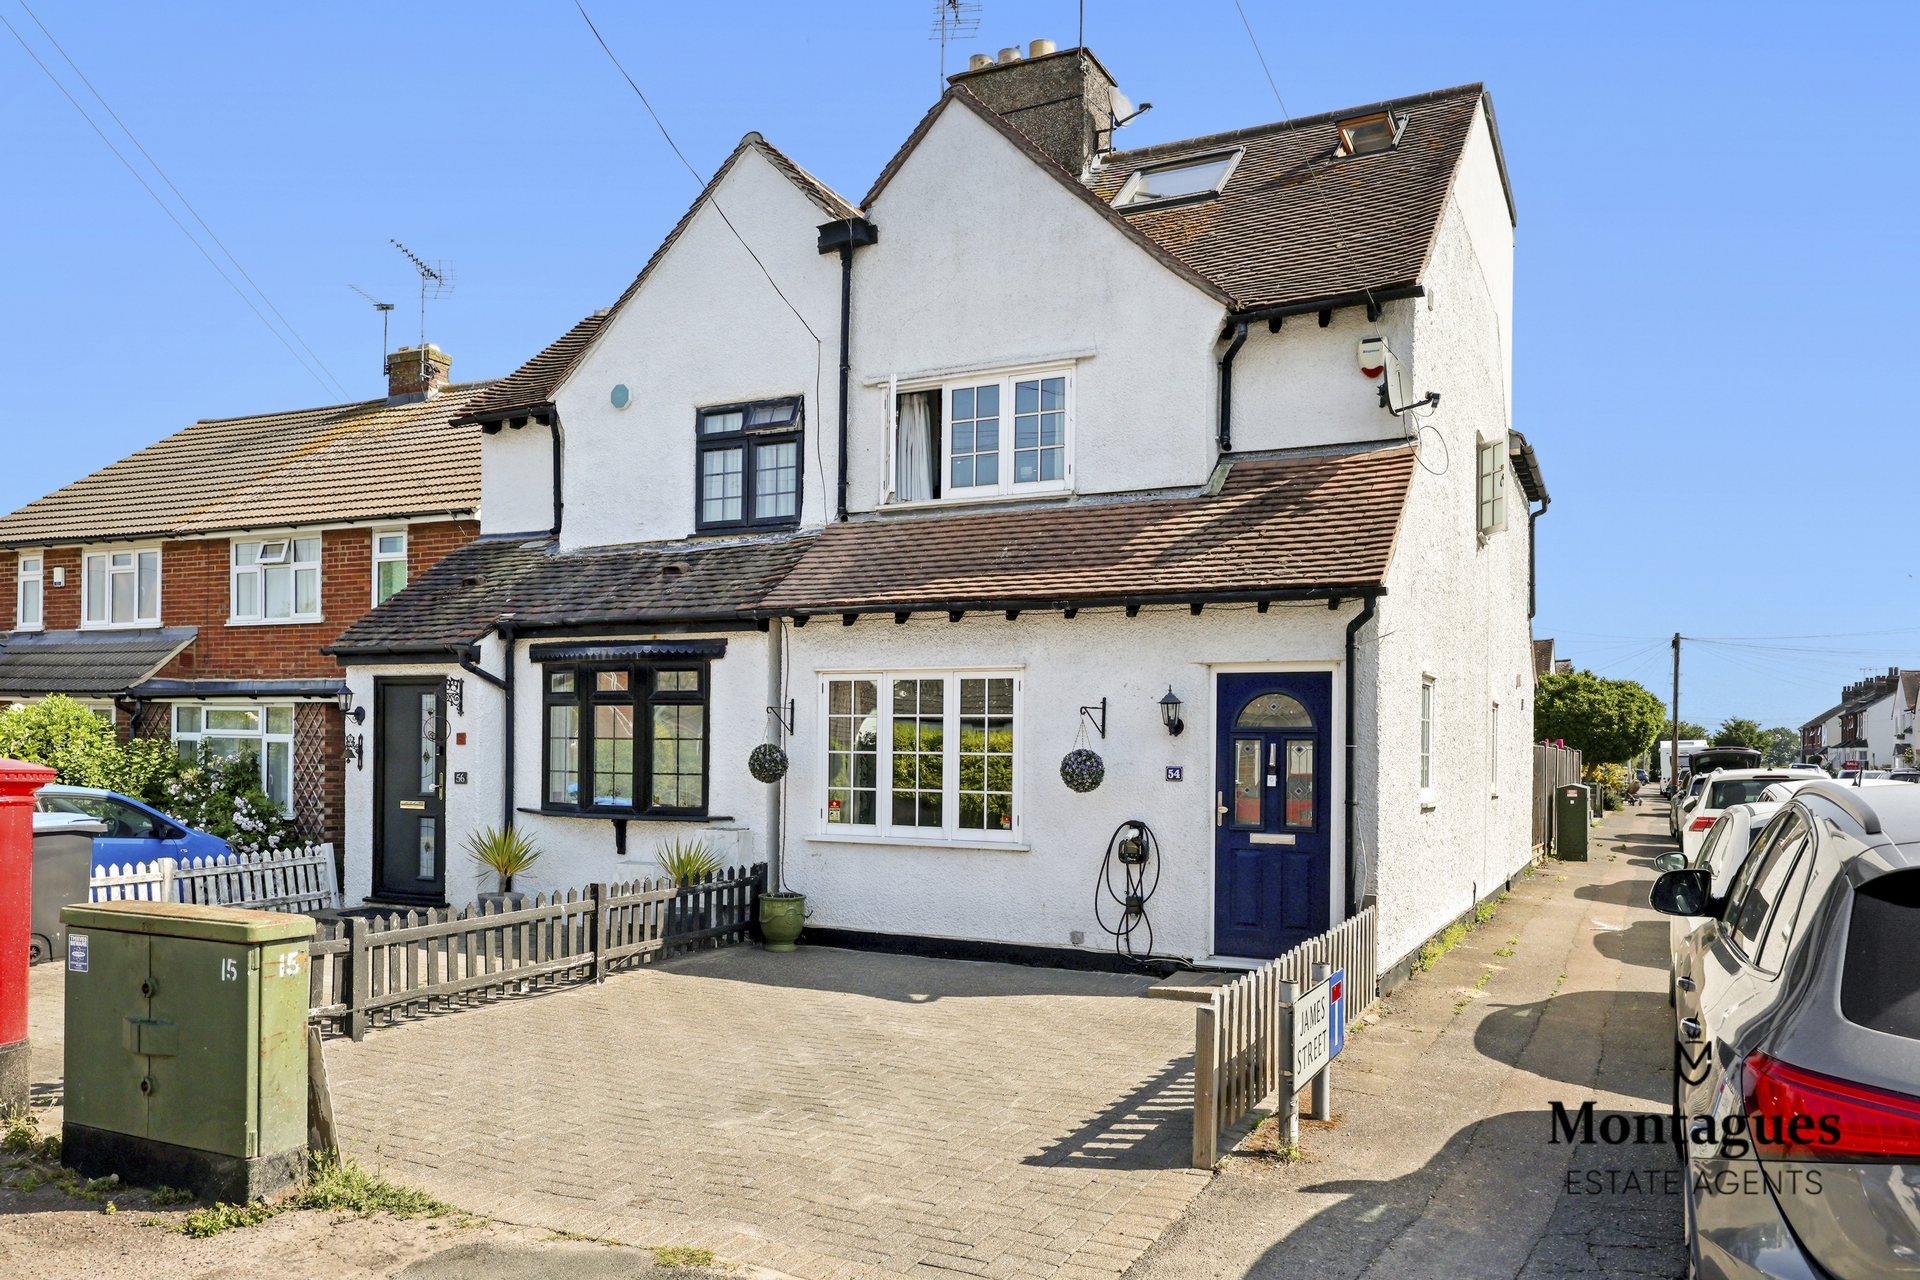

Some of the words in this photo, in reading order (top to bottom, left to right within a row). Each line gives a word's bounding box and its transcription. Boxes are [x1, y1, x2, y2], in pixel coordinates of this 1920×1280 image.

[456, 773, 466, 783] 56
[1168, 769, 1181, 779] 54
[221, 958, 238, 981] 15
[279, 951, 300, 978] 15
[1300, 996, 1326, 1037] JAMES
[1297, 1029, 1327, 1075] STREET
